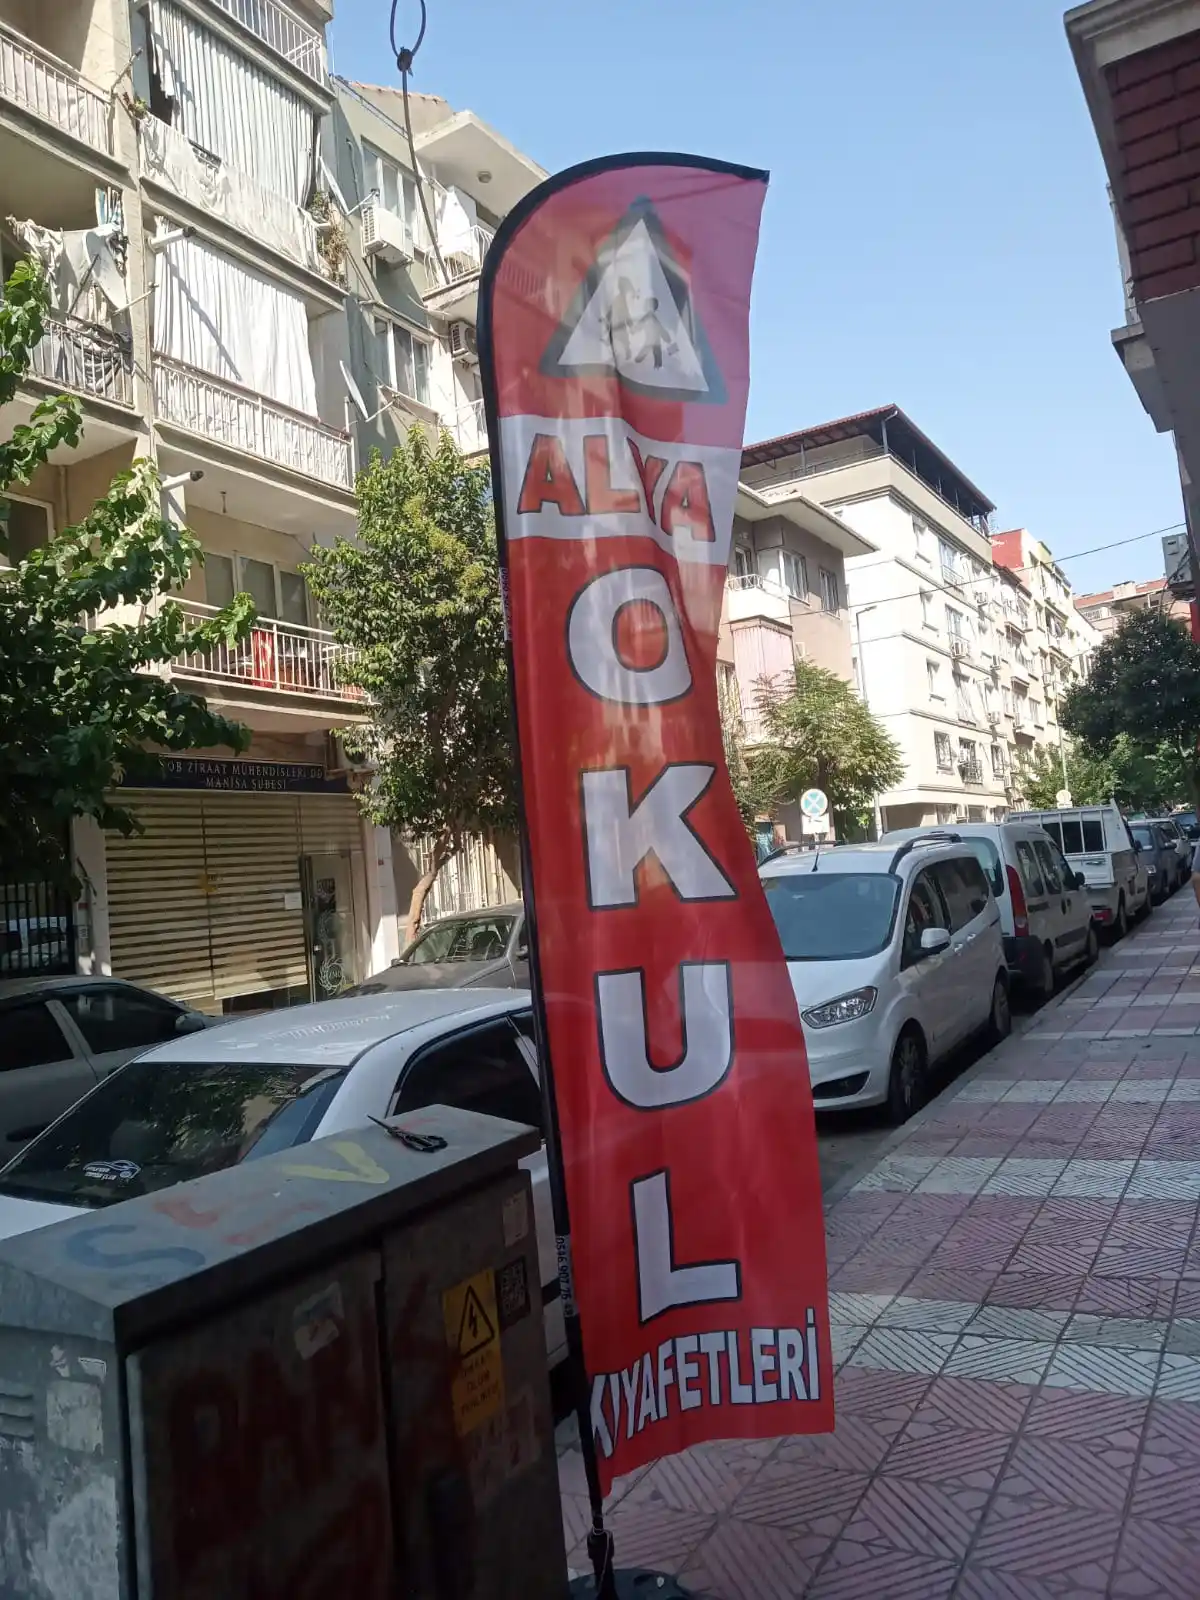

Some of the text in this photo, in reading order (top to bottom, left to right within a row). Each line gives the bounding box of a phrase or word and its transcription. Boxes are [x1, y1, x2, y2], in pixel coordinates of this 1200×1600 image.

[517, 433, 717, 543] ALYA
[566, 563, 741, 1326] OKUL
[589, 1307, 820, 1459] KIYAFETLERİ
